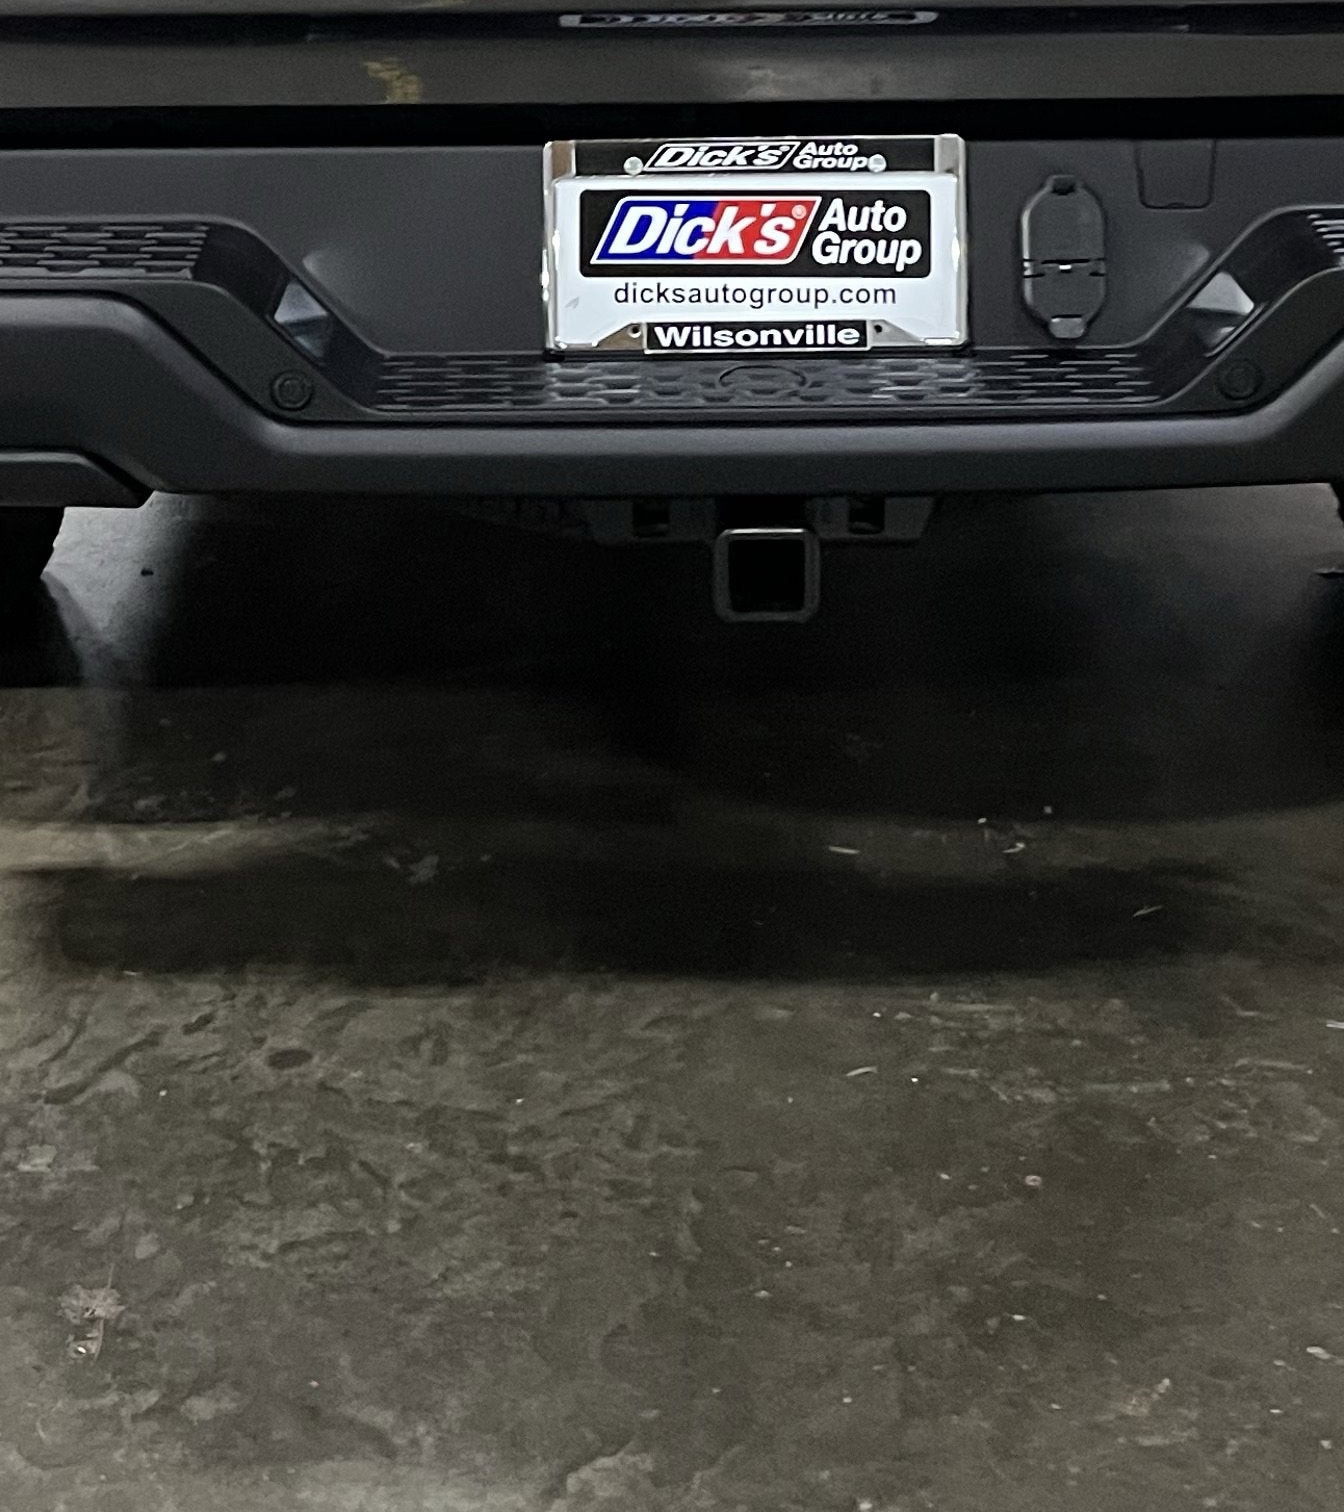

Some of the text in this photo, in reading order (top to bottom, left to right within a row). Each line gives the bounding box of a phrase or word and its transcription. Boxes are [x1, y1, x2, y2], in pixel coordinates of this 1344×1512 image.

[653, 146, 783, 168] Dick's
[798, 141, 859, 156] Auto
[792, 155, 869, 171] Group
[817, 197, 907, 232] Auto
[607, 202, 796, 257] Dick's
[811, 230, 922, 272] Group
[613, 282, 897, 309] dicksautogroup.com
[654, 324, 860, 348] Wilsonville
